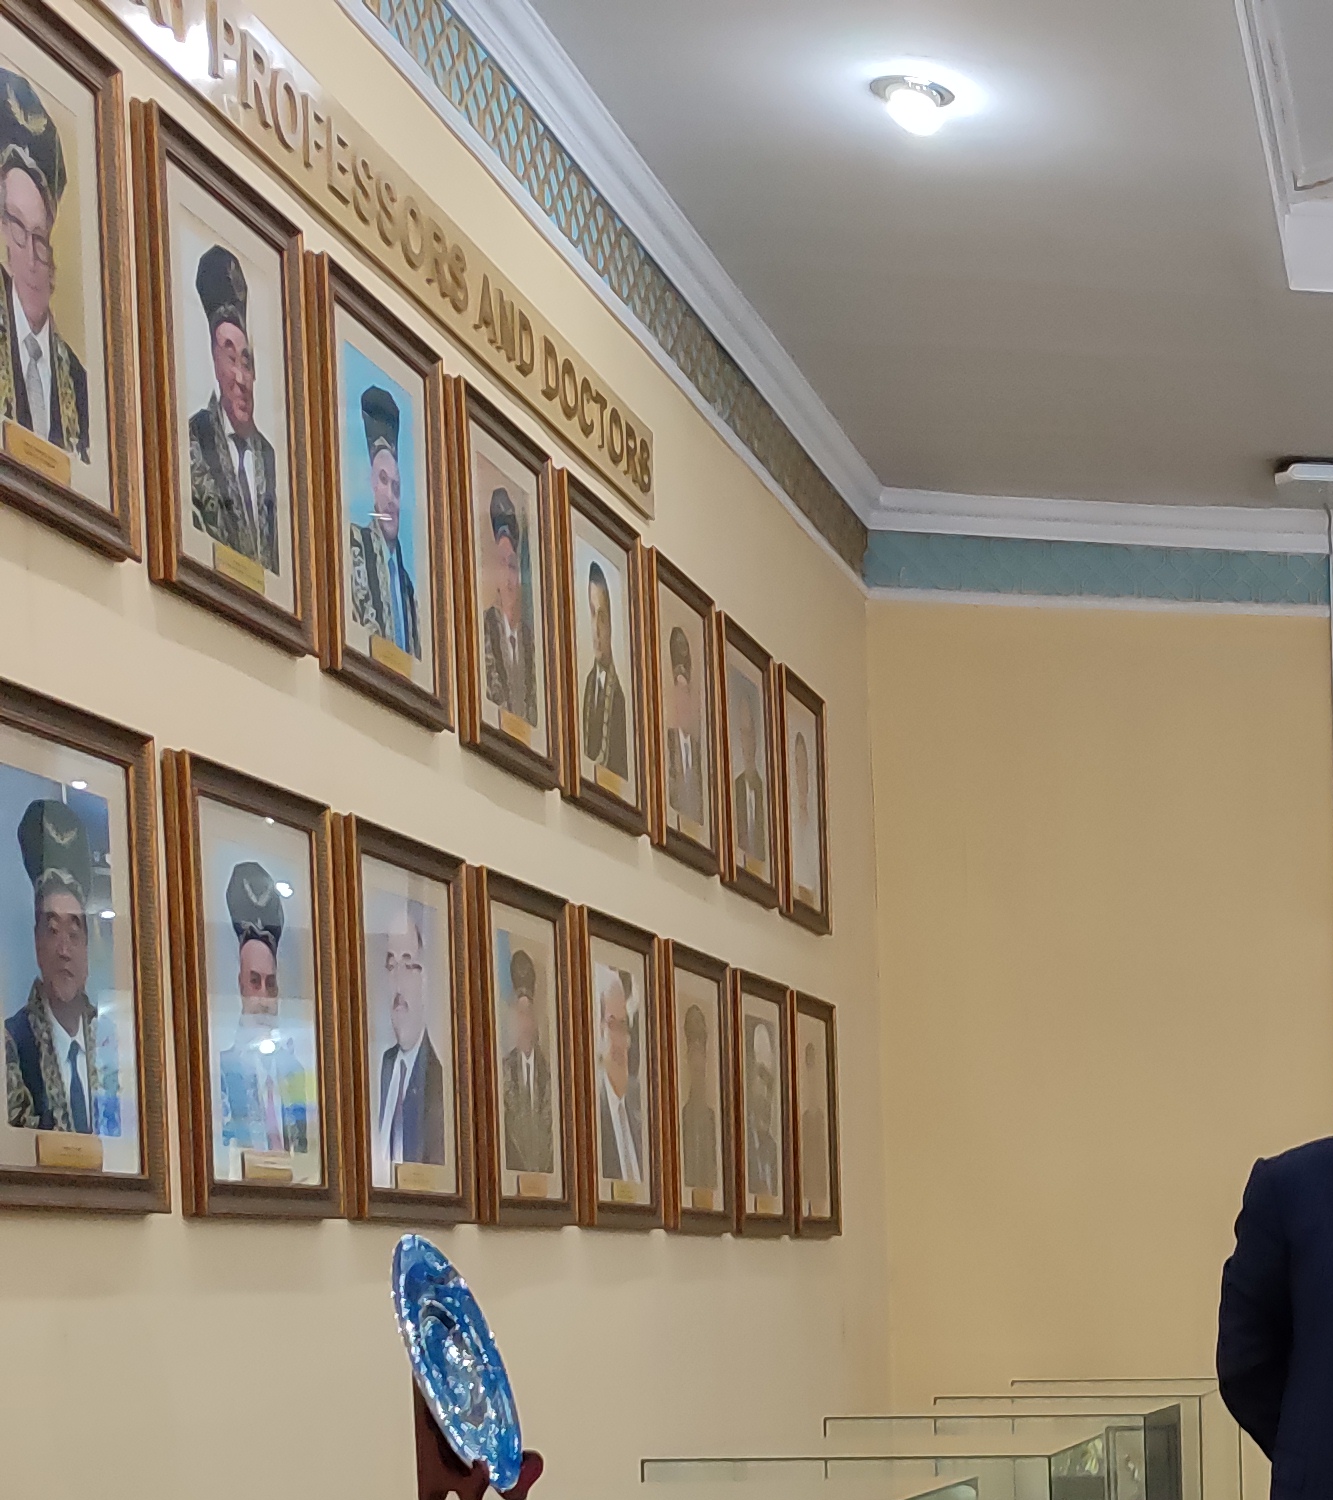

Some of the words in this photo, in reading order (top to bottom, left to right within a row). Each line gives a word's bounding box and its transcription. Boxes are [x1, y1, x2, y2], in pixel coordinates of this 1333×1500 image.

[206, 0, 469, 315] PROFESSORS
[472, 272, 535, 378] AND
[540, 334, 651, 494] DOCTORS
